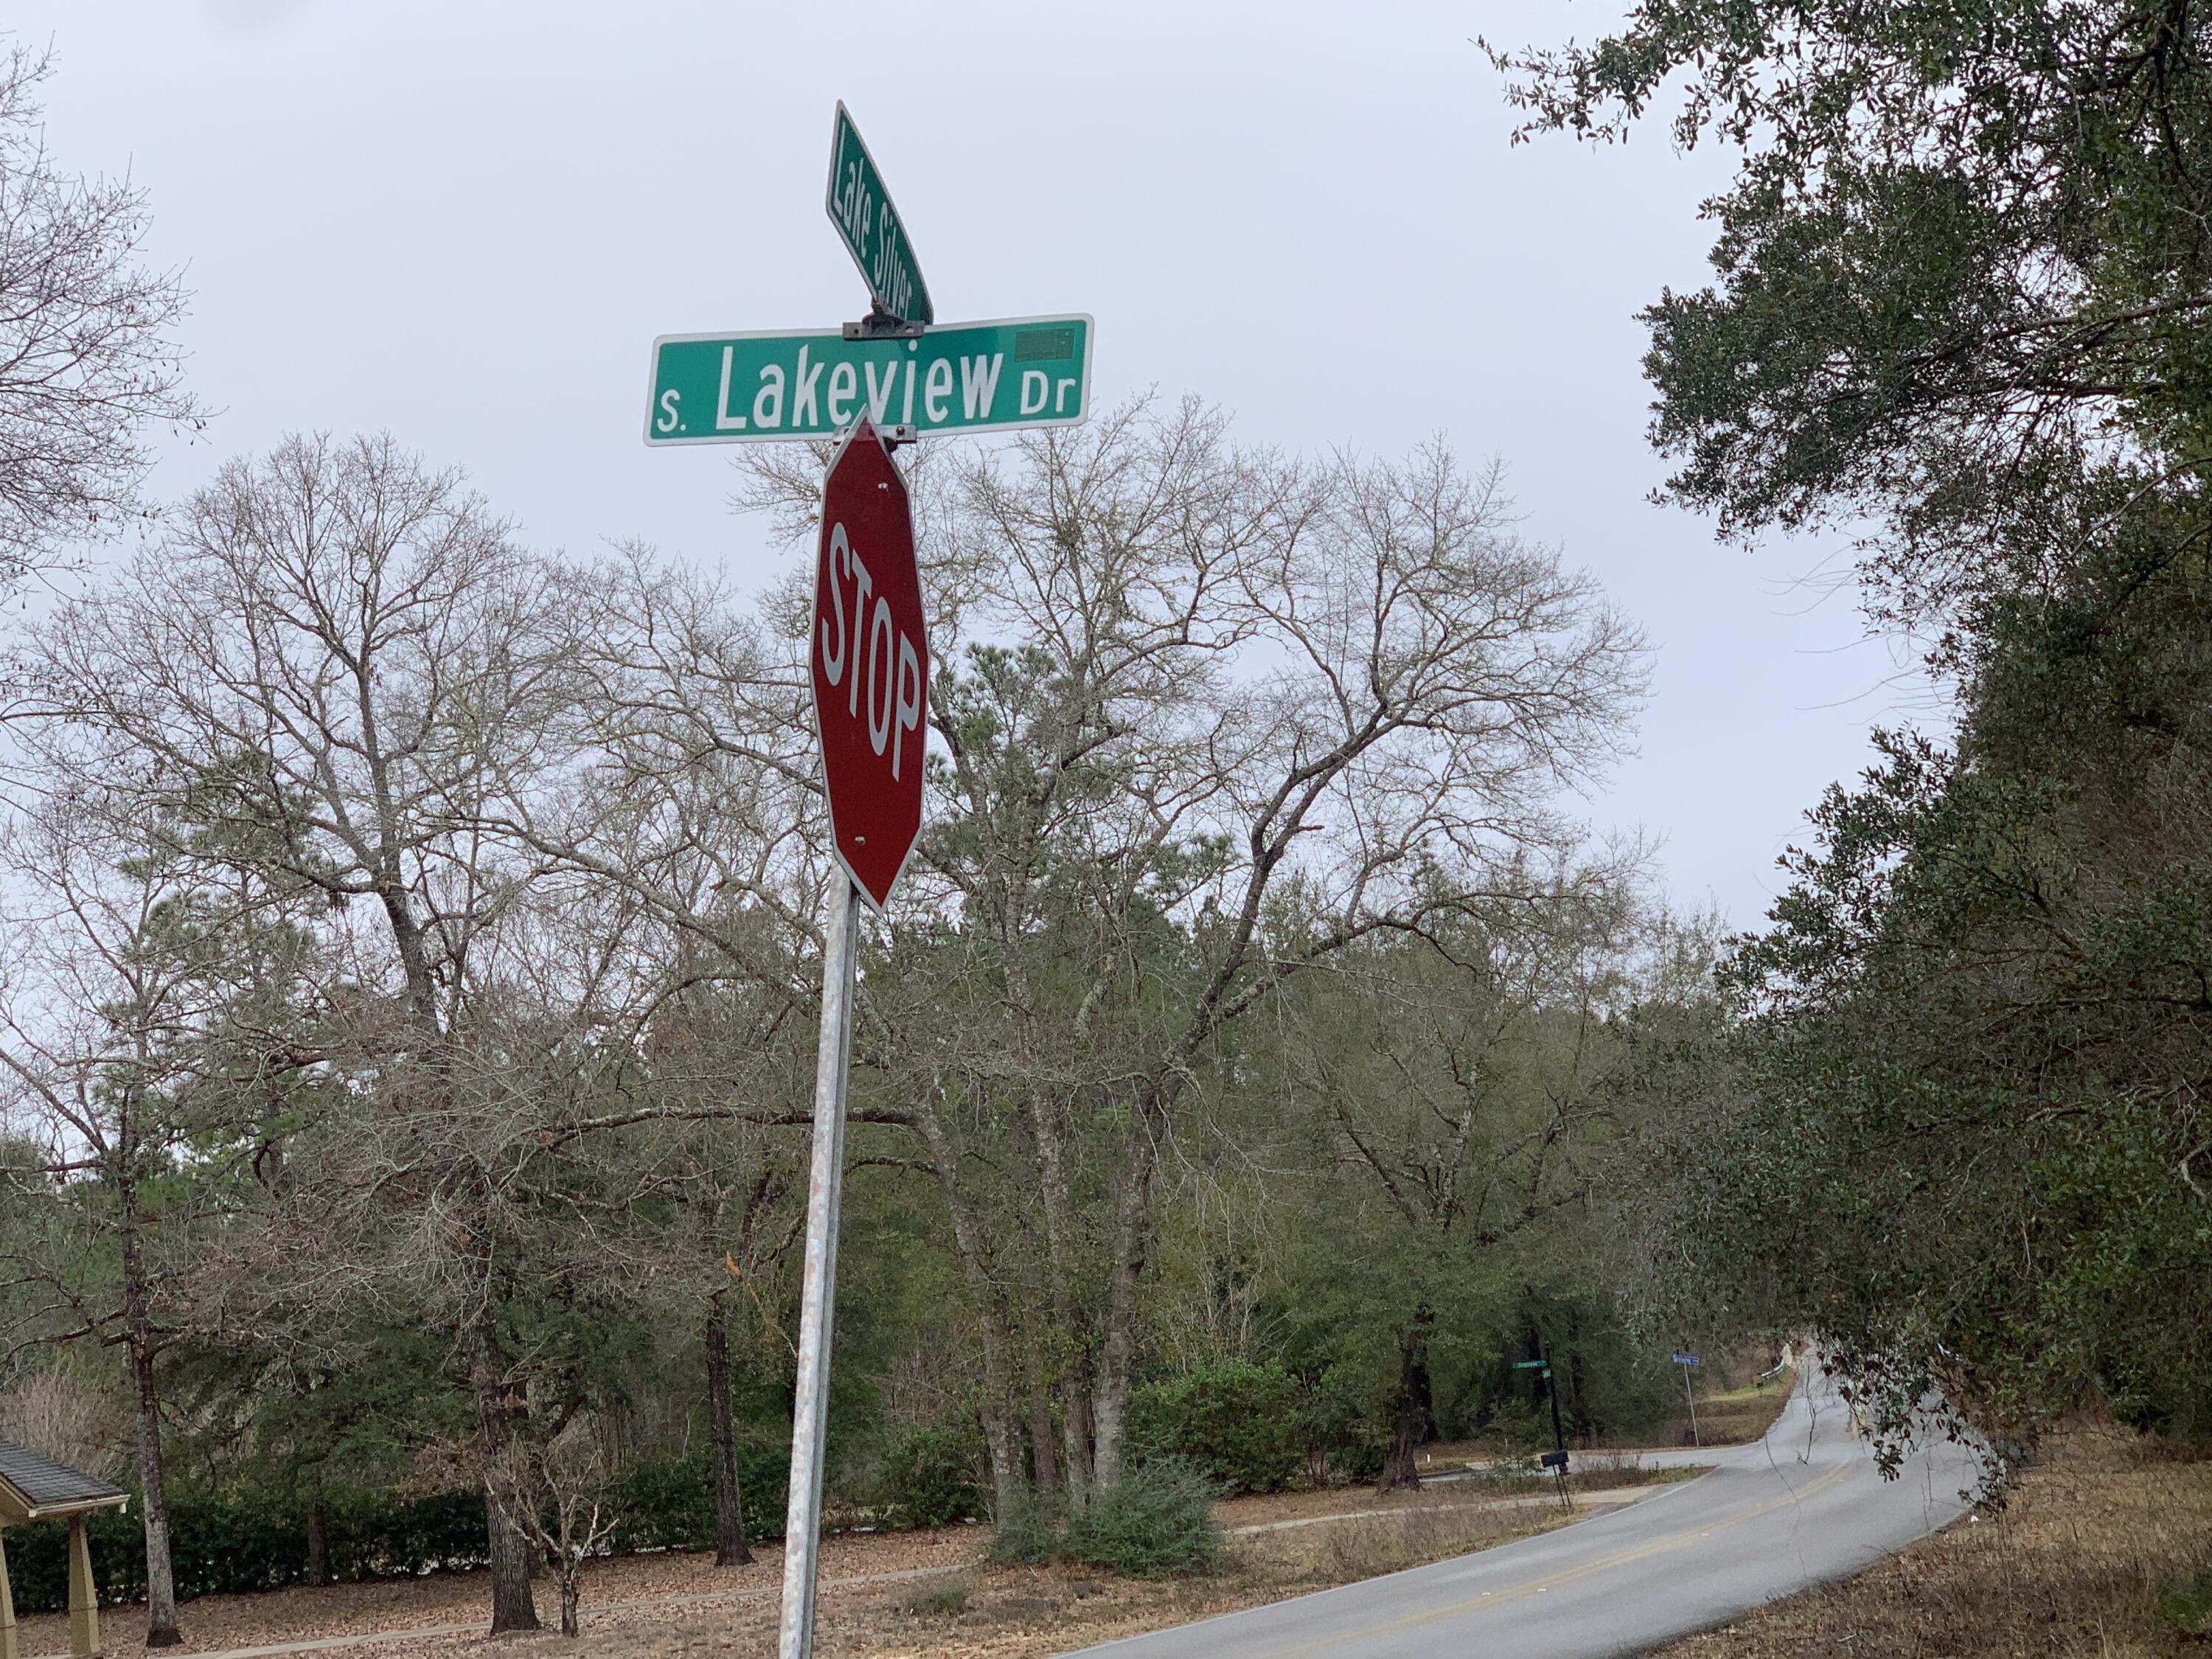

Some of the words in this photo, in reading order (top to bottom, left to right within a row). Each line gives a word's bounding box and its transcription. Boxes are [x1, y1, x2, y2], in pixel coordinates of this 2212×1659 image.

[834, 122, 872, 259] Lake
[874, 201, 912, 321] Silver
[657, 389, 687, 433] S.
[715, 339, 1004, 431] Lakeview
[1020, 370, 1077, 415] Dr
[822, 522, 921, 783] STOP
